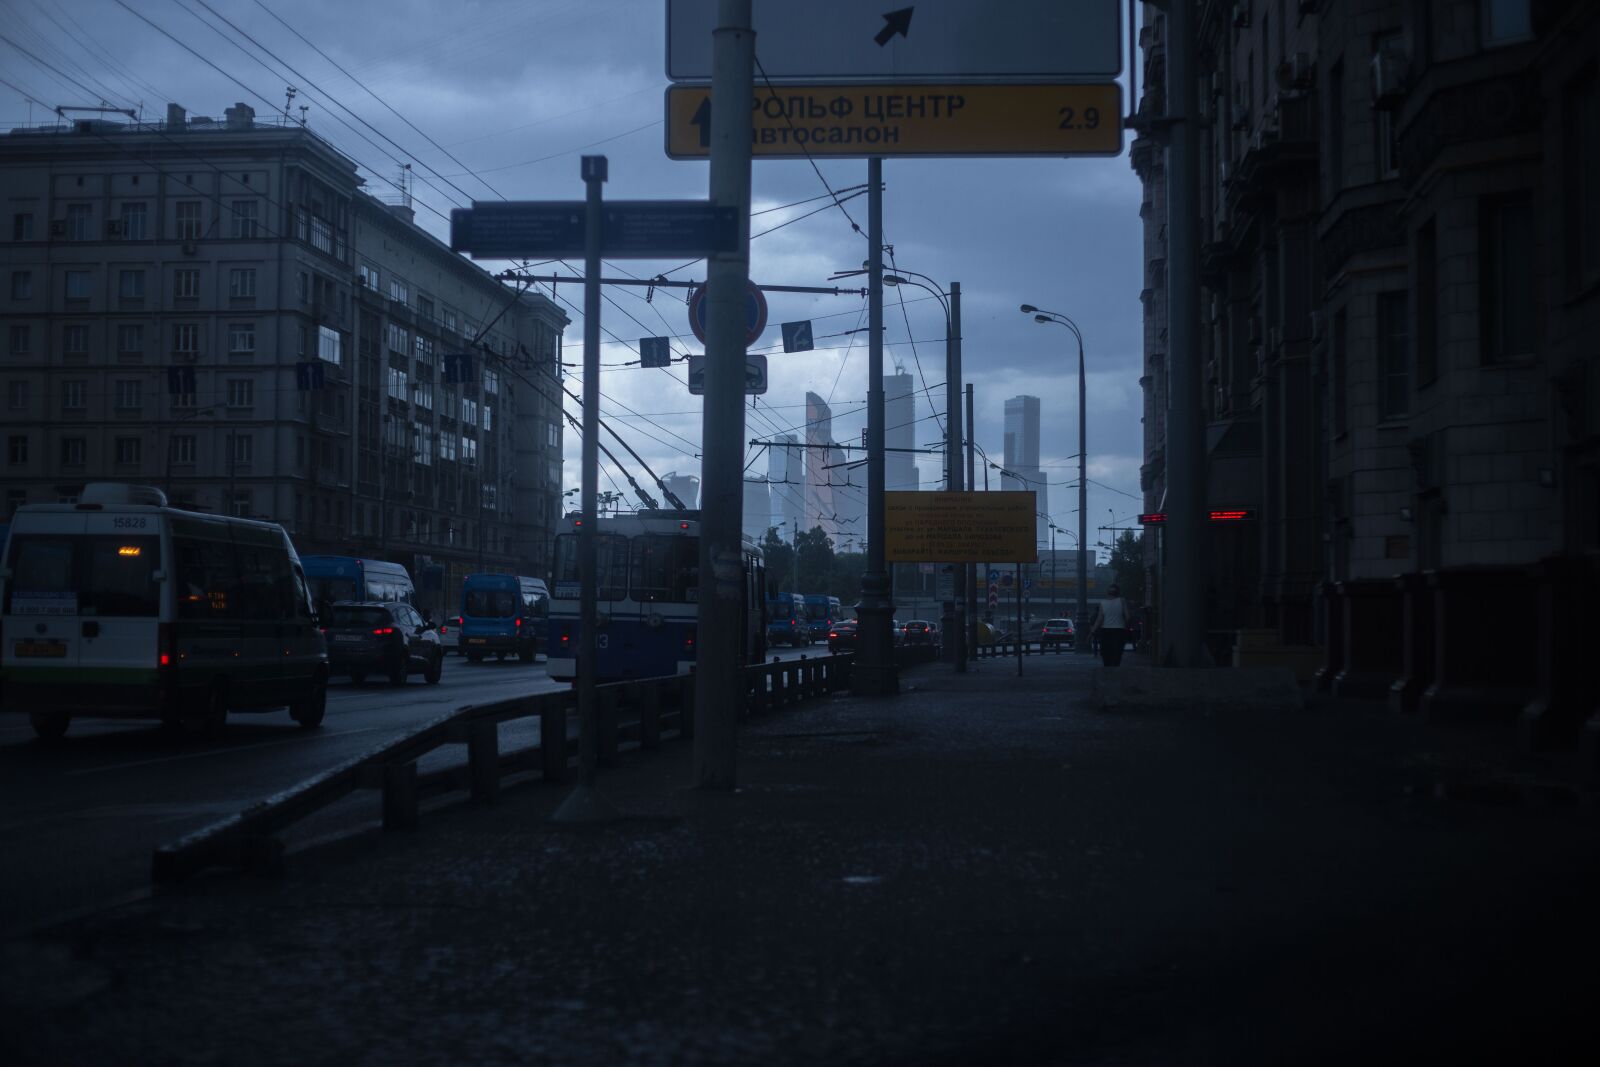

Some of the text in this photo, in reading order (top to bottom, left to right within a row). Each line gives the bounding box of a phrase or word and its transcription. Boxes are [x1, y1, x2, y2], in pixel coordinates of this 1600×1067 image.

[864, 95, 966, 123] ЦЕНТР
[1058, 107, 1100, 130] 2.9
[112, 517, 146, 528] 15828
